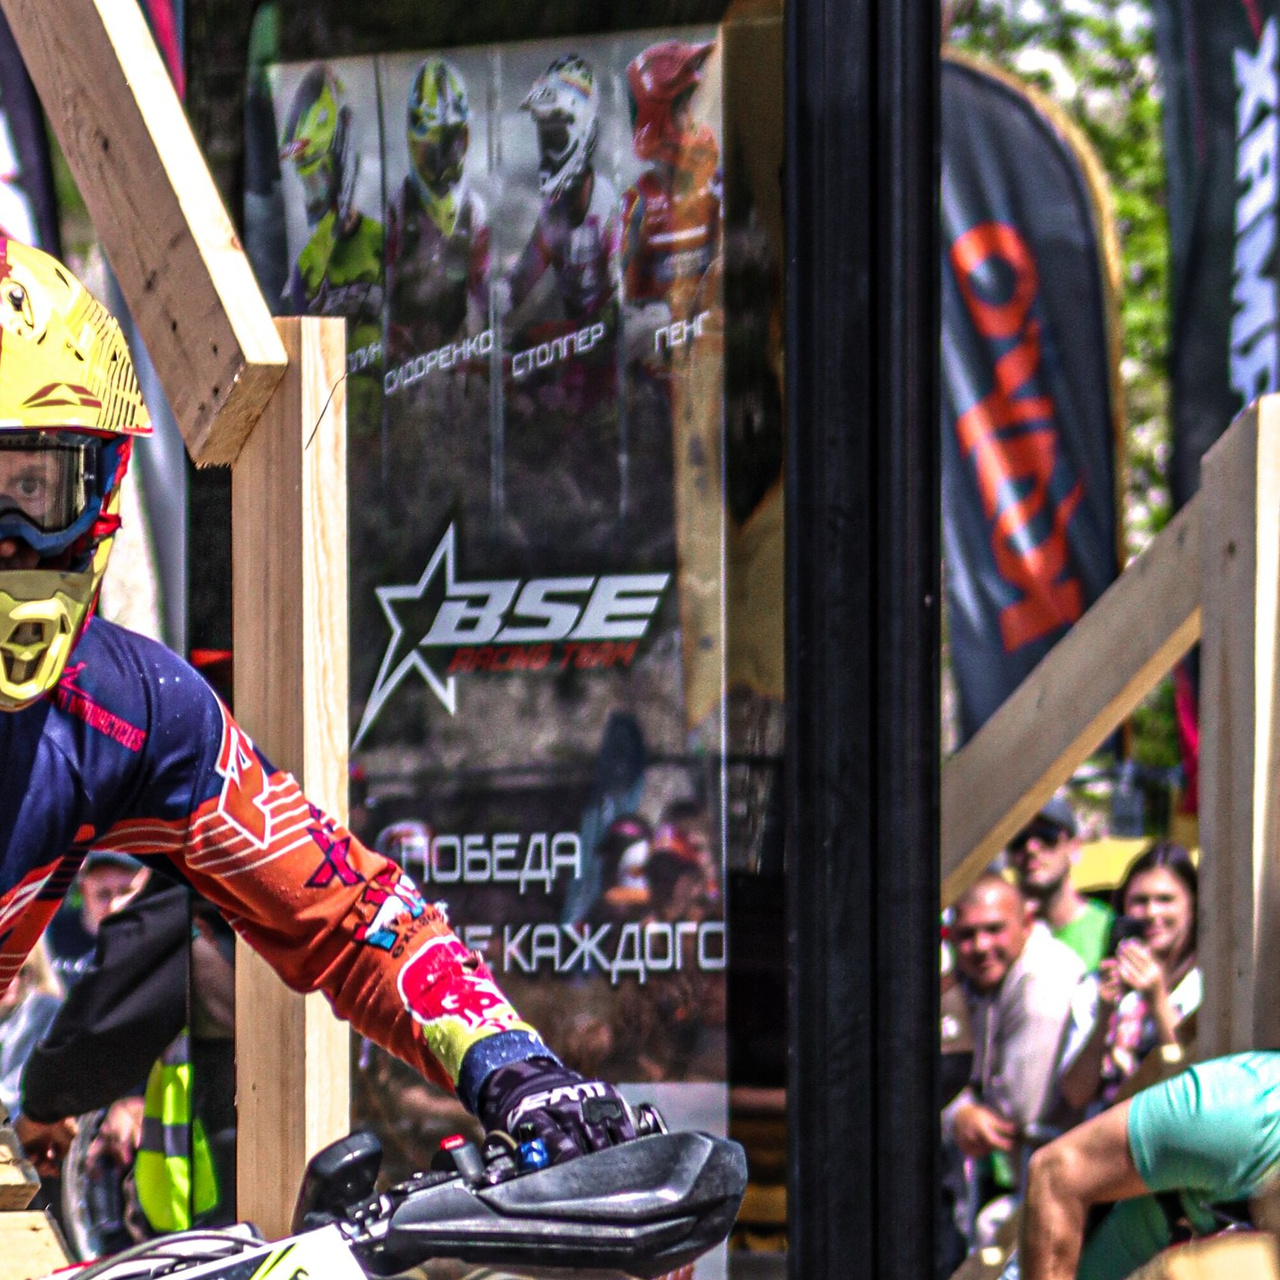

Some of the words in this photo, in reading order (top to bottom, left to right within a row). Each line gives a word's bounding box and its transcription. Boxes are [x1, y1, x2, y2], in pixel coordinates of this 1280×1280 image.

[419, 572, 670, 646] BSE
[401, 831, 581, 894] ПОБЕДА
[504, 921, 726, 986] КАЖДОГО
